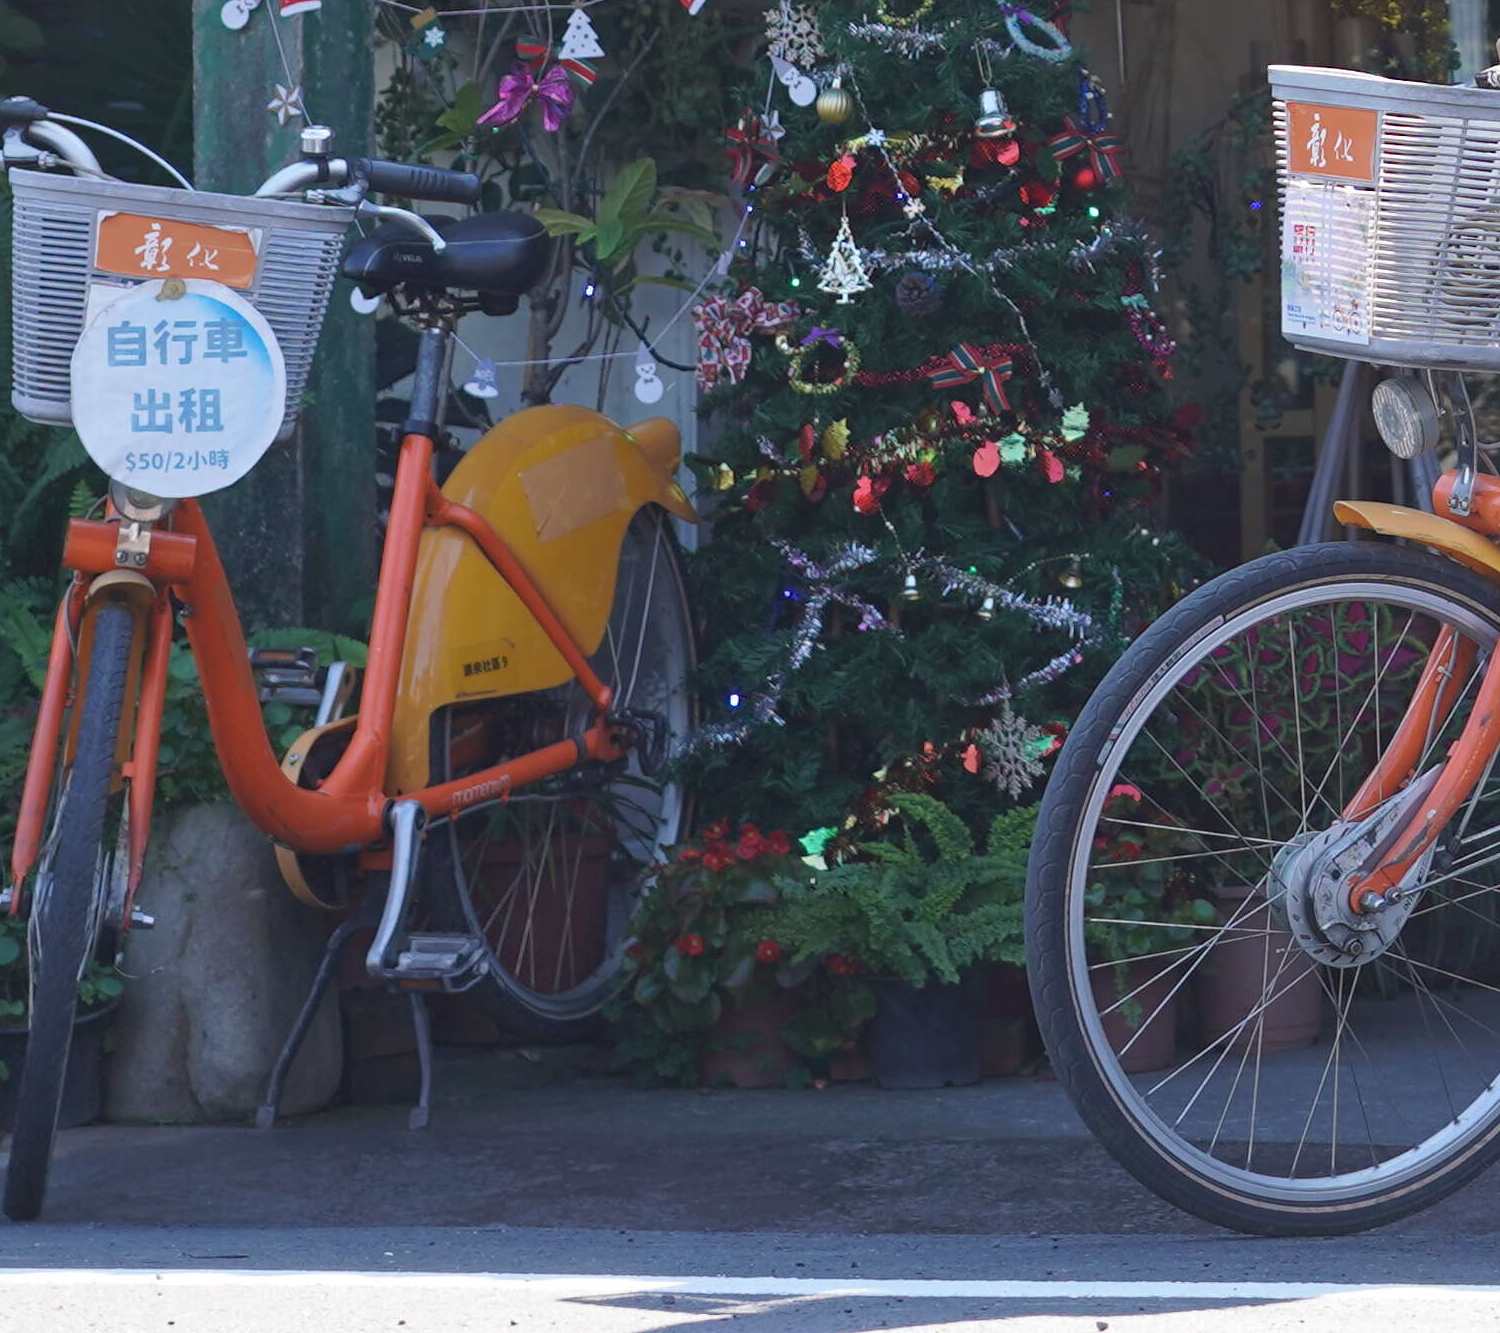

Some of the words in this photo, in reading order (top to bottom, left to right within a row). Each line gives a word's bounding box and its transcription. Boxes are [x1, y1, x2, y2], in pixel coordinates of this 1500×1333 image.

[134, 223, 220, 271] 彰化
[107, 319, 248, 367] 自行車
[131, 387, 224, 434] 出租
[125, 450, 229, 472] $50/2小時
